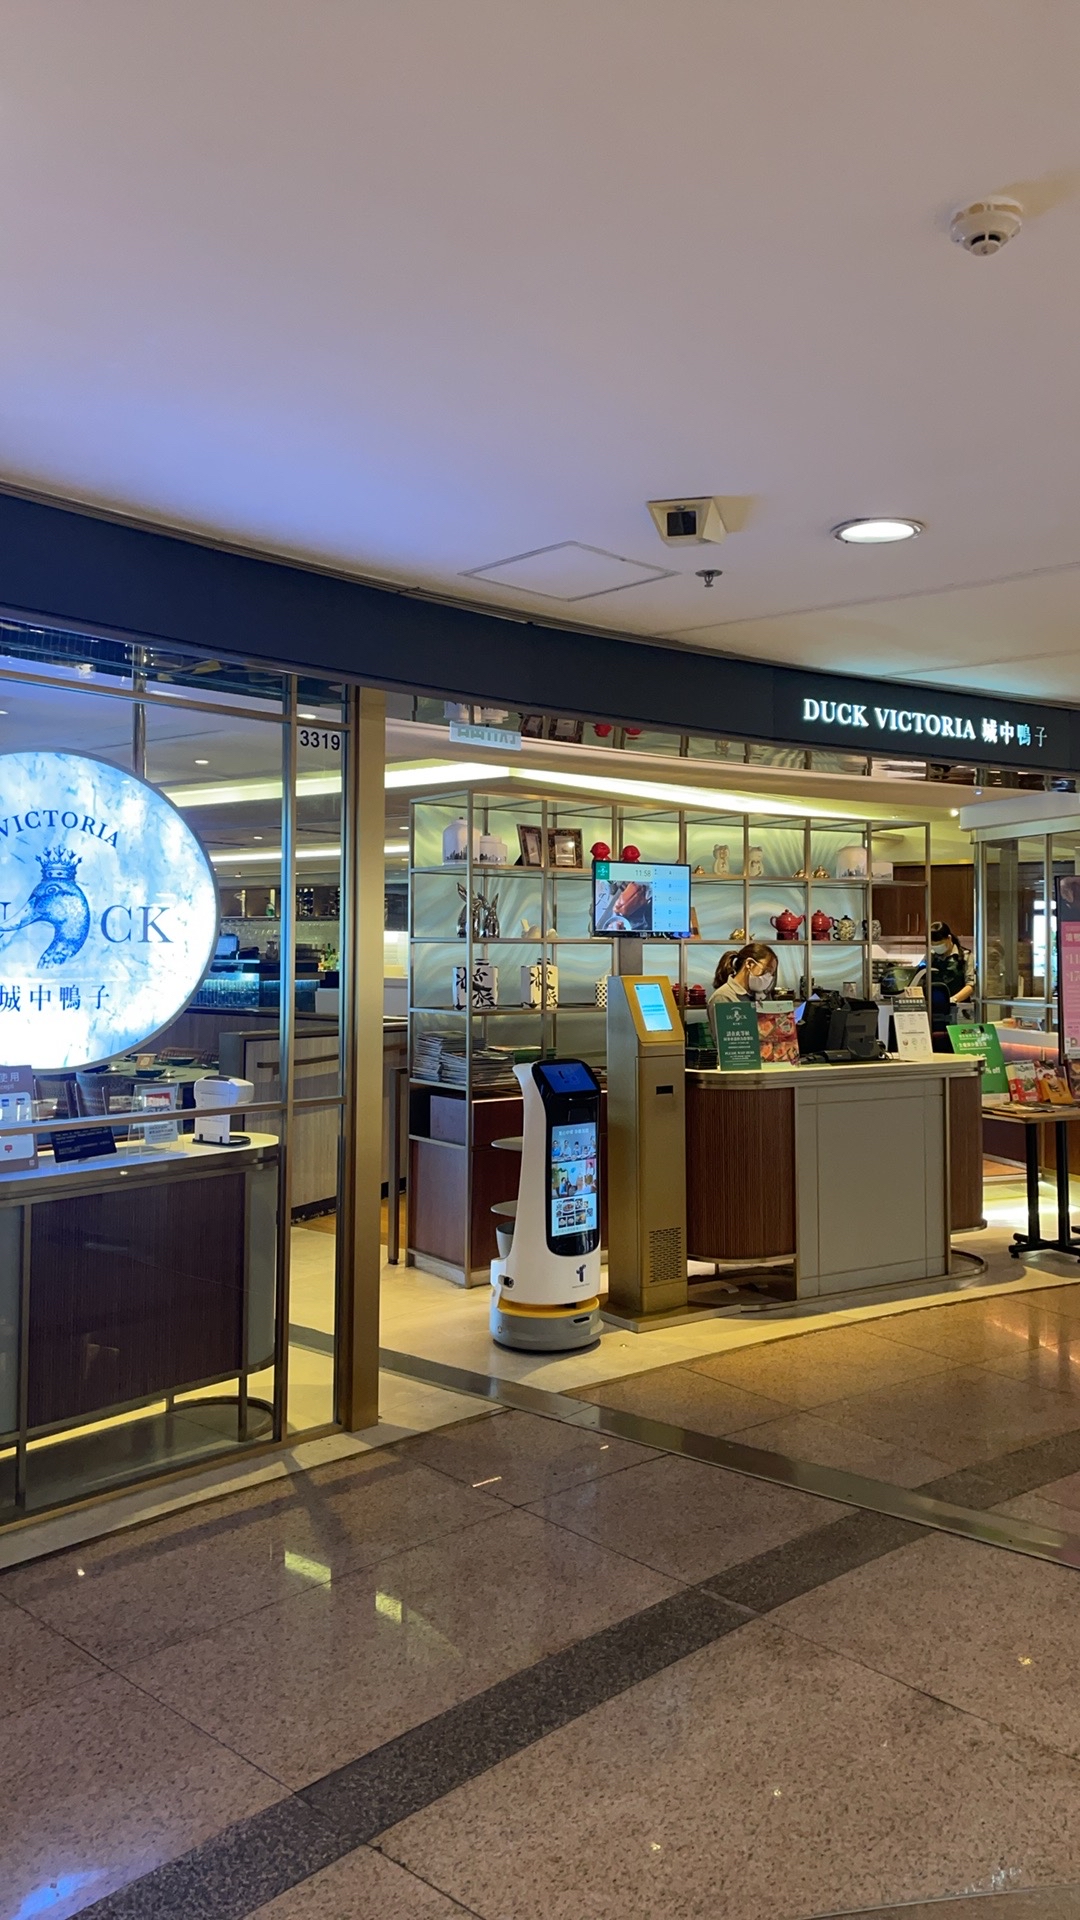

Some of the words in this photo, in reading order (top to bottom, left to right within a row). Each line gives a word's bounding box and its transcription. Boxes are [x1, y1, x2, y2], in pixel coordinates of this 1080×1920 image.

[300, 729, 341, 750] 3319
[803, 698, 869, 727] DUCK
[874, 706, 976, 740] VICTORIA
[981, 717, 1047, 748] 城中鴨子
[0, 809, 119, 848] VICTORIA
[0, 984, 110, 1012] 城中鴨子
